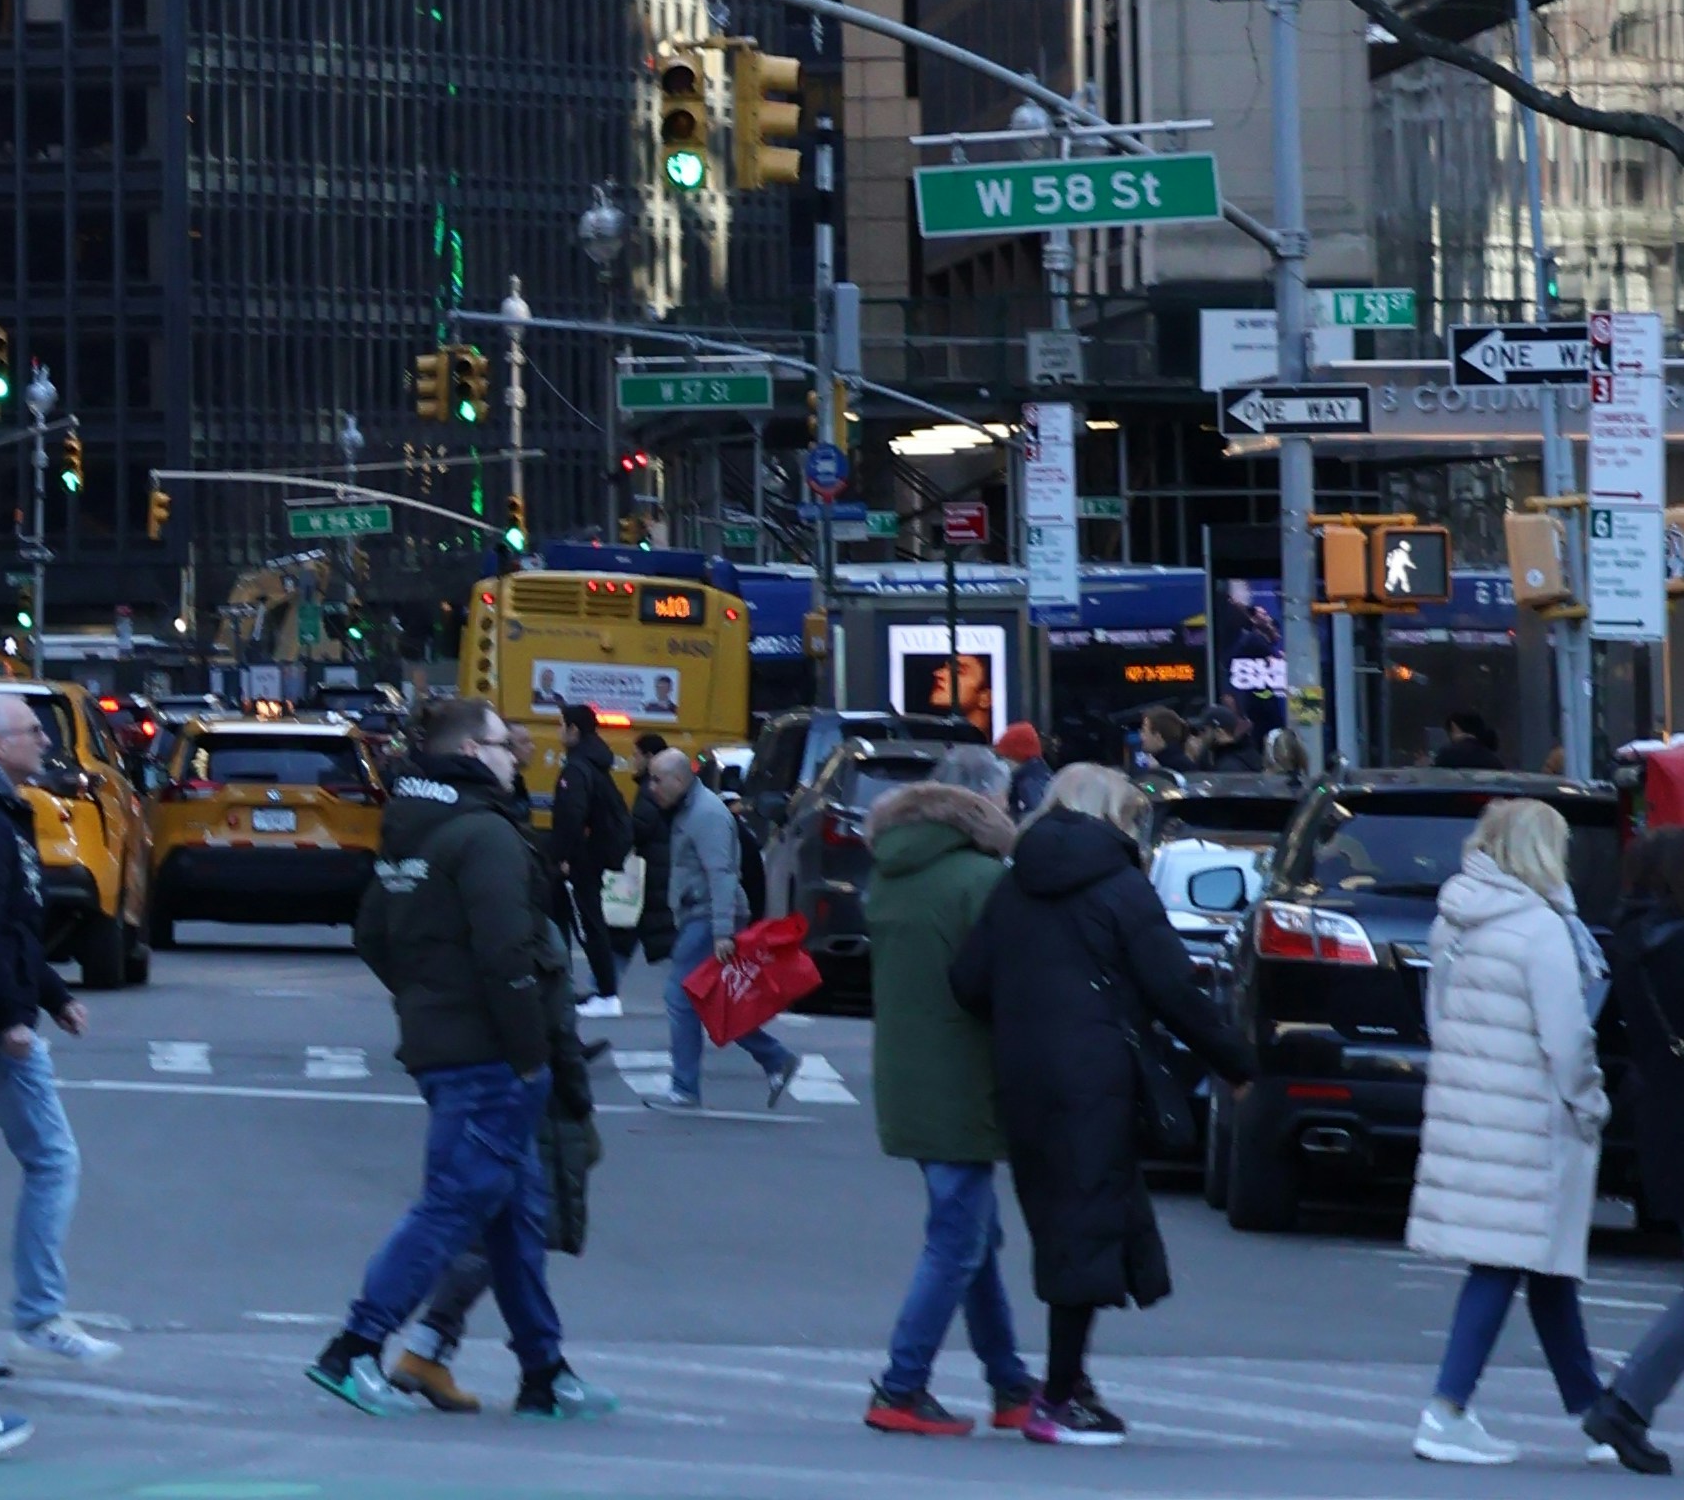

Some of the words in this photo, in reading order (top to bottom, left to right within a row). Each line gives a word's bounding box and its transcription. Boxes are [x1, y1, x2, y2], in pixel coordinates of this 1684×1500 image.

[975, 177, 1013, 218] W
[1032, 173, 1096, 215] 58
[1111, 169, 1163, 210] St
[1338, 293, 1357, 324] W
[1363, 293, 1390, 324] 58
[1390, 293, 1411, 311] ST
[1481, 343, 1534, 369] ONE
[1557, 343, 1592, 369] WA
[659, 380, 675, 402] W
[681, 380, 704, 403] 57
[710, 379, 731, 402] St
[1414, 384, 1591, 413] COLUMU
[1593, 376, 1610, 403] 3
[1242, 399, 1285, 422] ONE
[1306, 399, 1352, 422] WAY
[1593, 510, 1610, 538] 6
